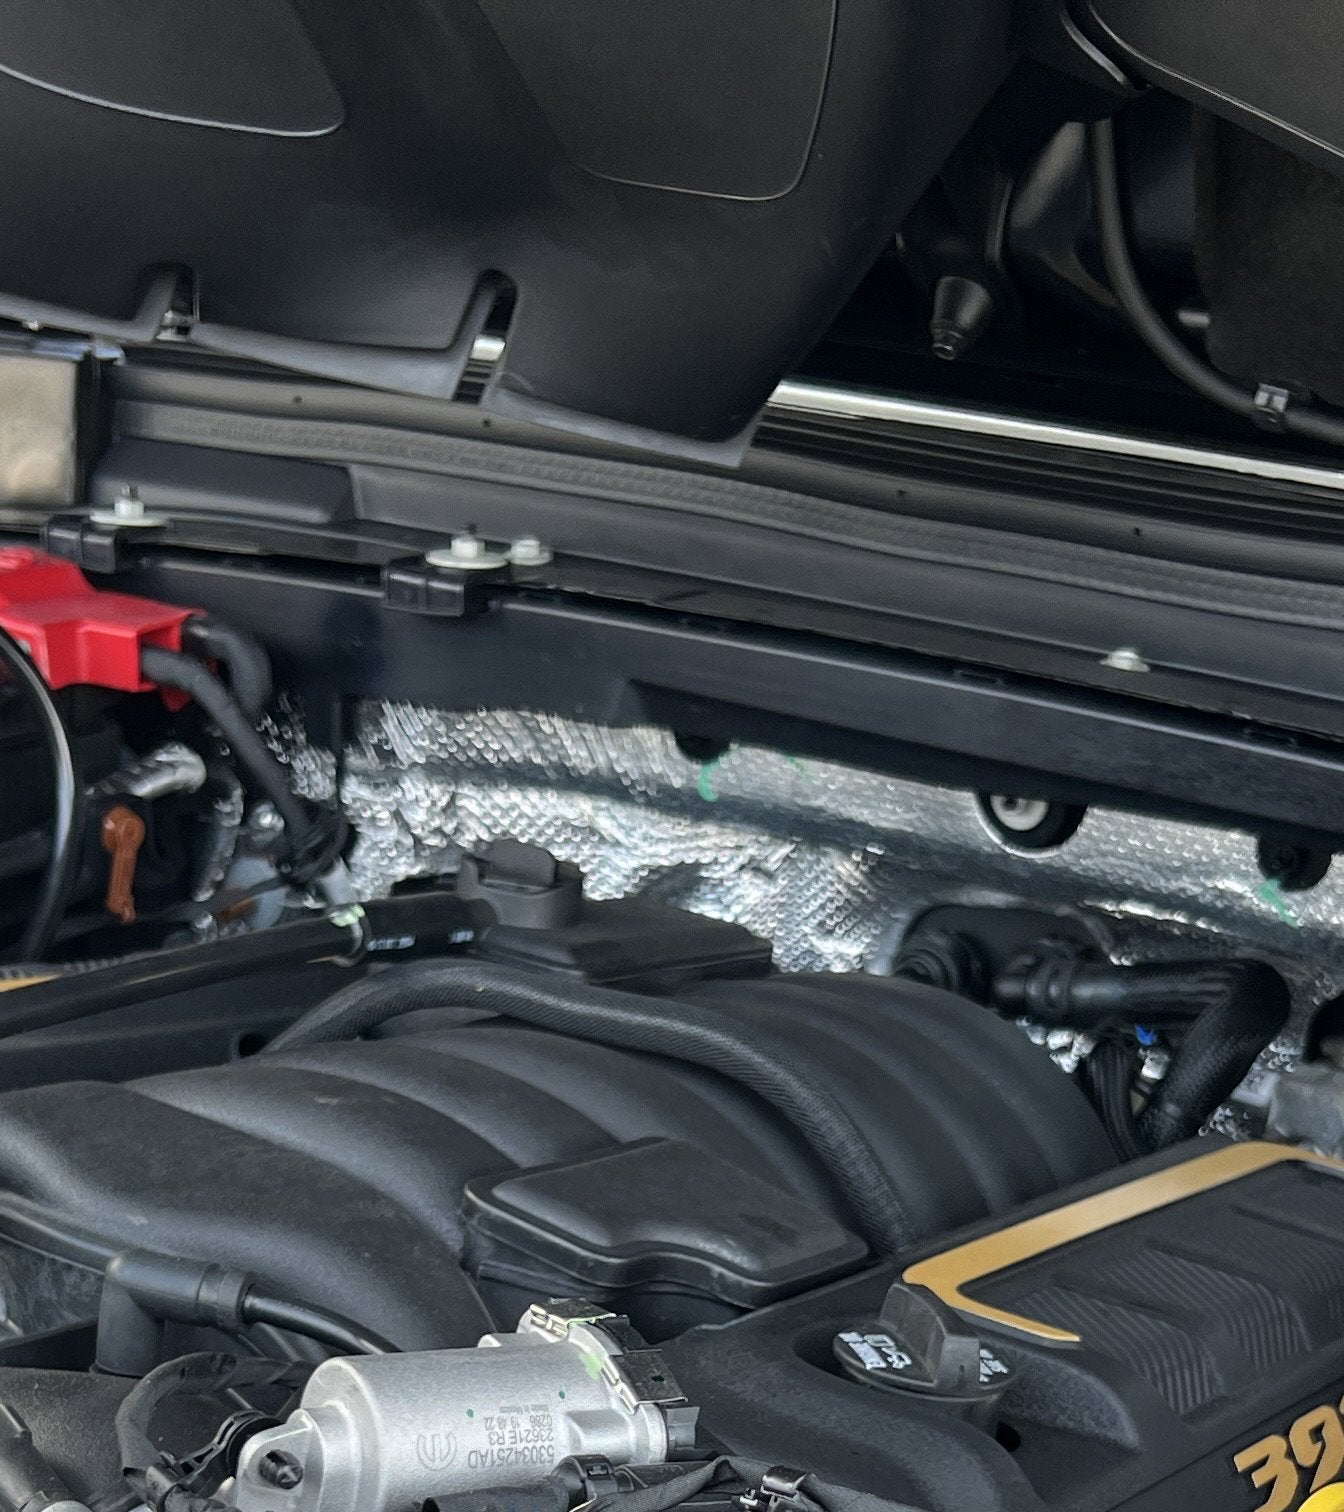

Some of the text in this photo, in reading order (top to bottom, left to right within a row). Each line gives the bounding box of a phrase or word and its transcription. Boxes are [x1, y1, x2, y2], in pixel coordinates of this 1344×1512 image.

[488, 1427, 554, 1446] 23621E R3
[467, 1444, 555, 1470] 53034251AD
